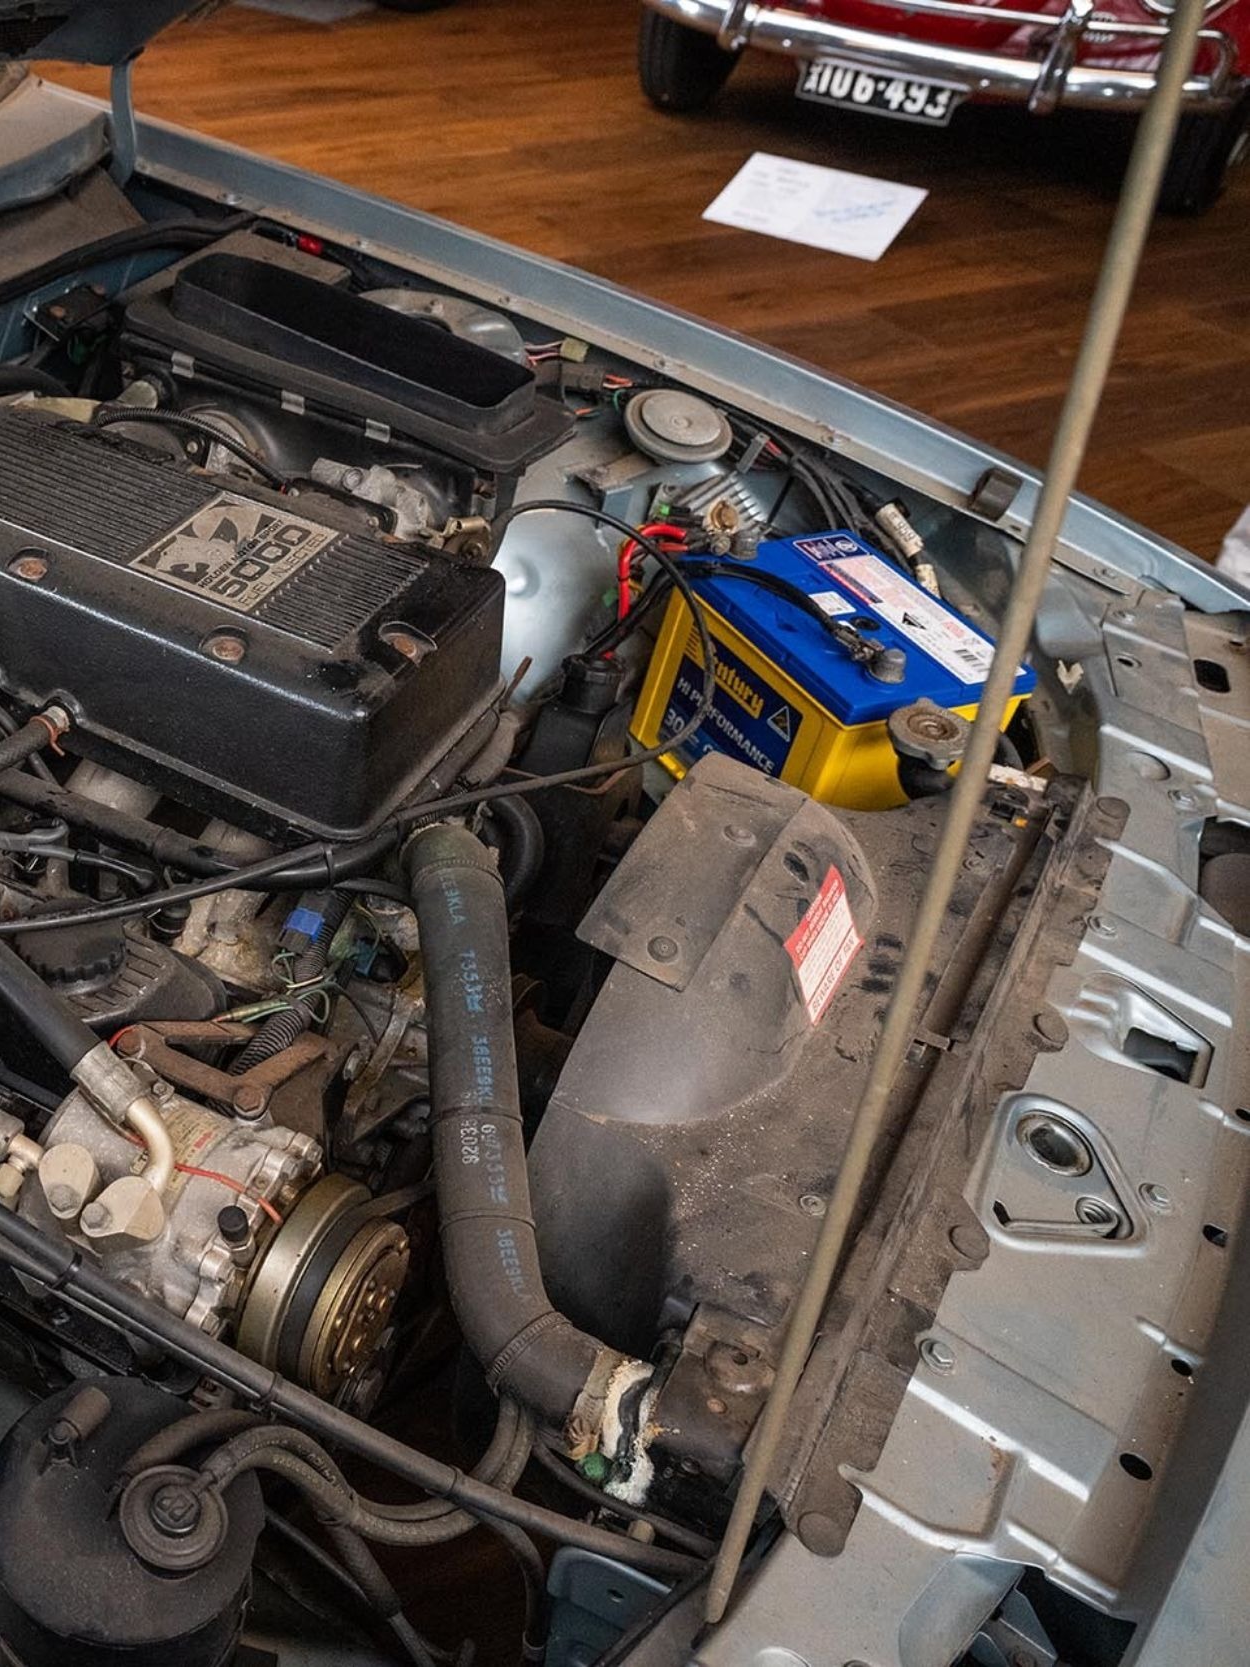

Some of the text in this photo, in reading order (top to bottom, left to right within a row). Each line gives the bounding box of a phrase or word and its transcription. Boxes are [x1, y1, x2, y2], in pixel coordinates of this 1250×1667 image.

[210, 524, 311, 598] 5000
[238, 532, 329, 605] FUEL INJECTED
[714, 656, 764, 717] ntury
[664, 708, 685, 733] 30
